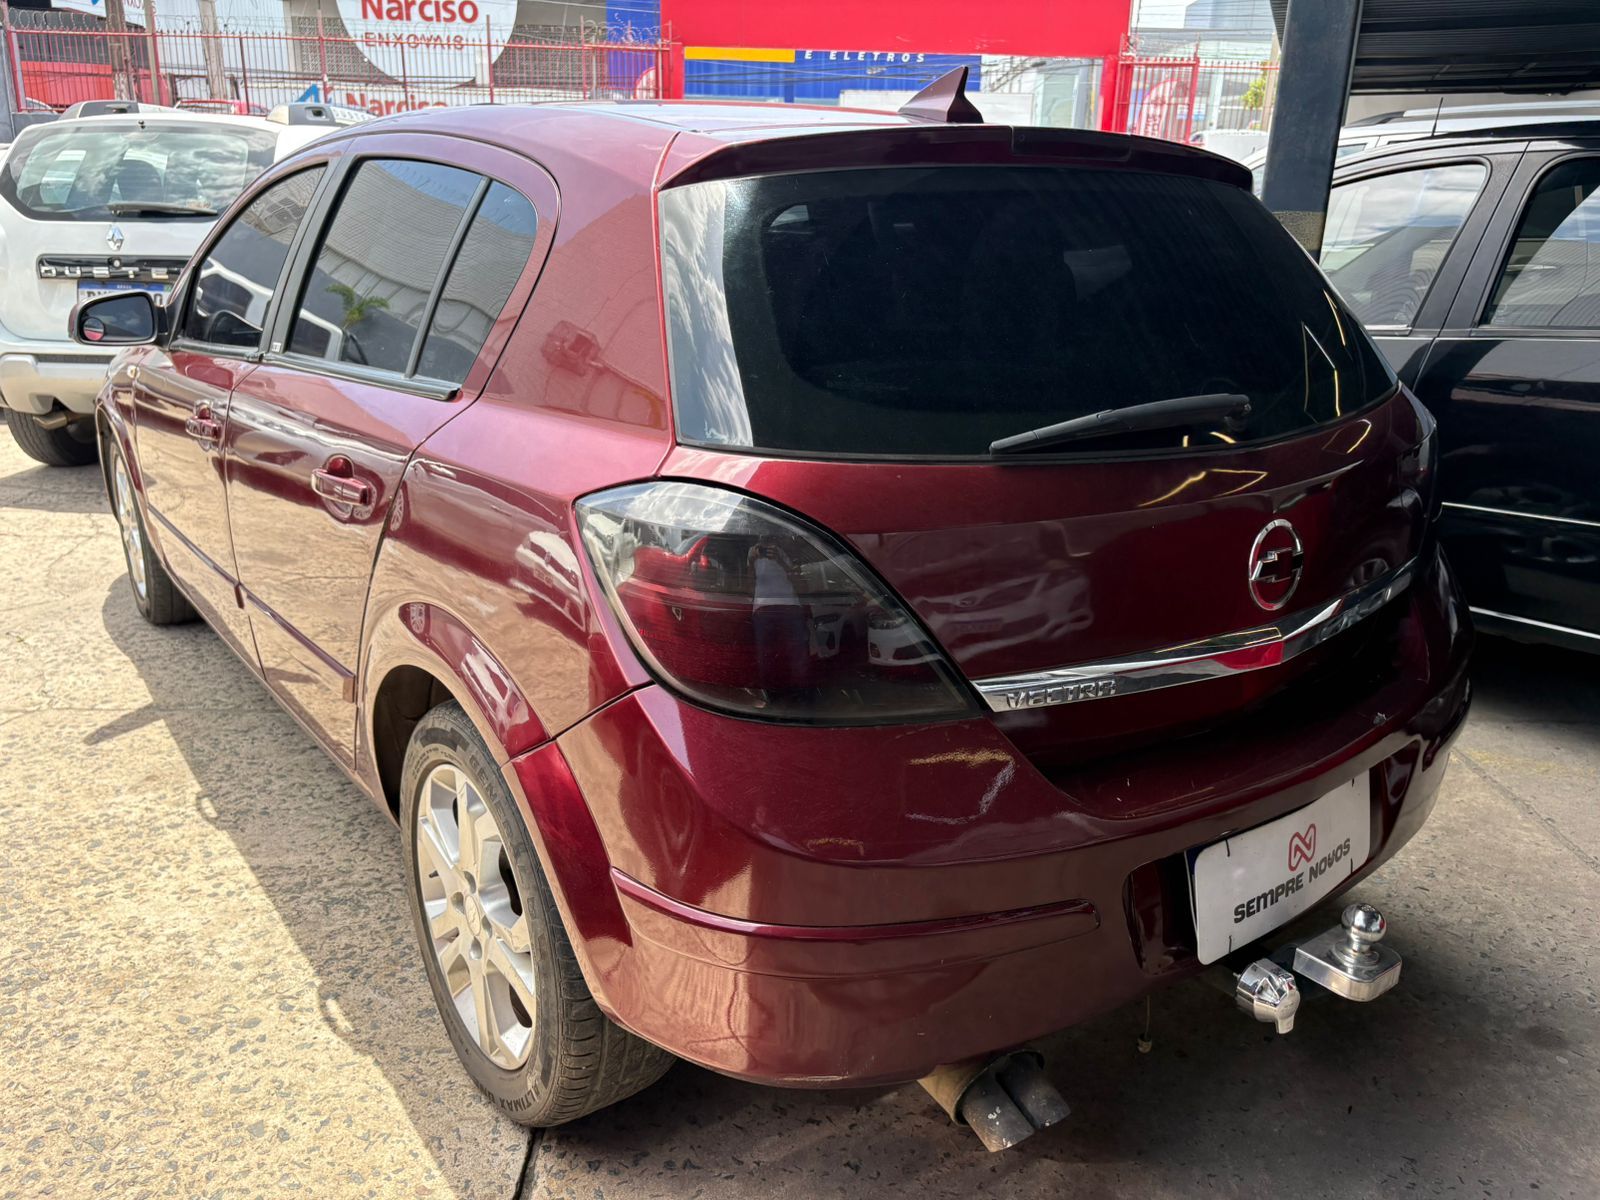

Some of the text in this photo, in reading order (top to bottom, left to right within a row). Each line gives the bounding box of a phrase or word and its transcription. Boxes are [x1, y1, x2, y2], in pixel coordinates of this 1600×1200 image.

[361, 0, 479, 23] Narciso
[829, 50, 925, 63] ELETROS
[1006, 679, 1117, 709] VECTRA
[1233, 838, 1351, 924] SEMPRE NOVOS
